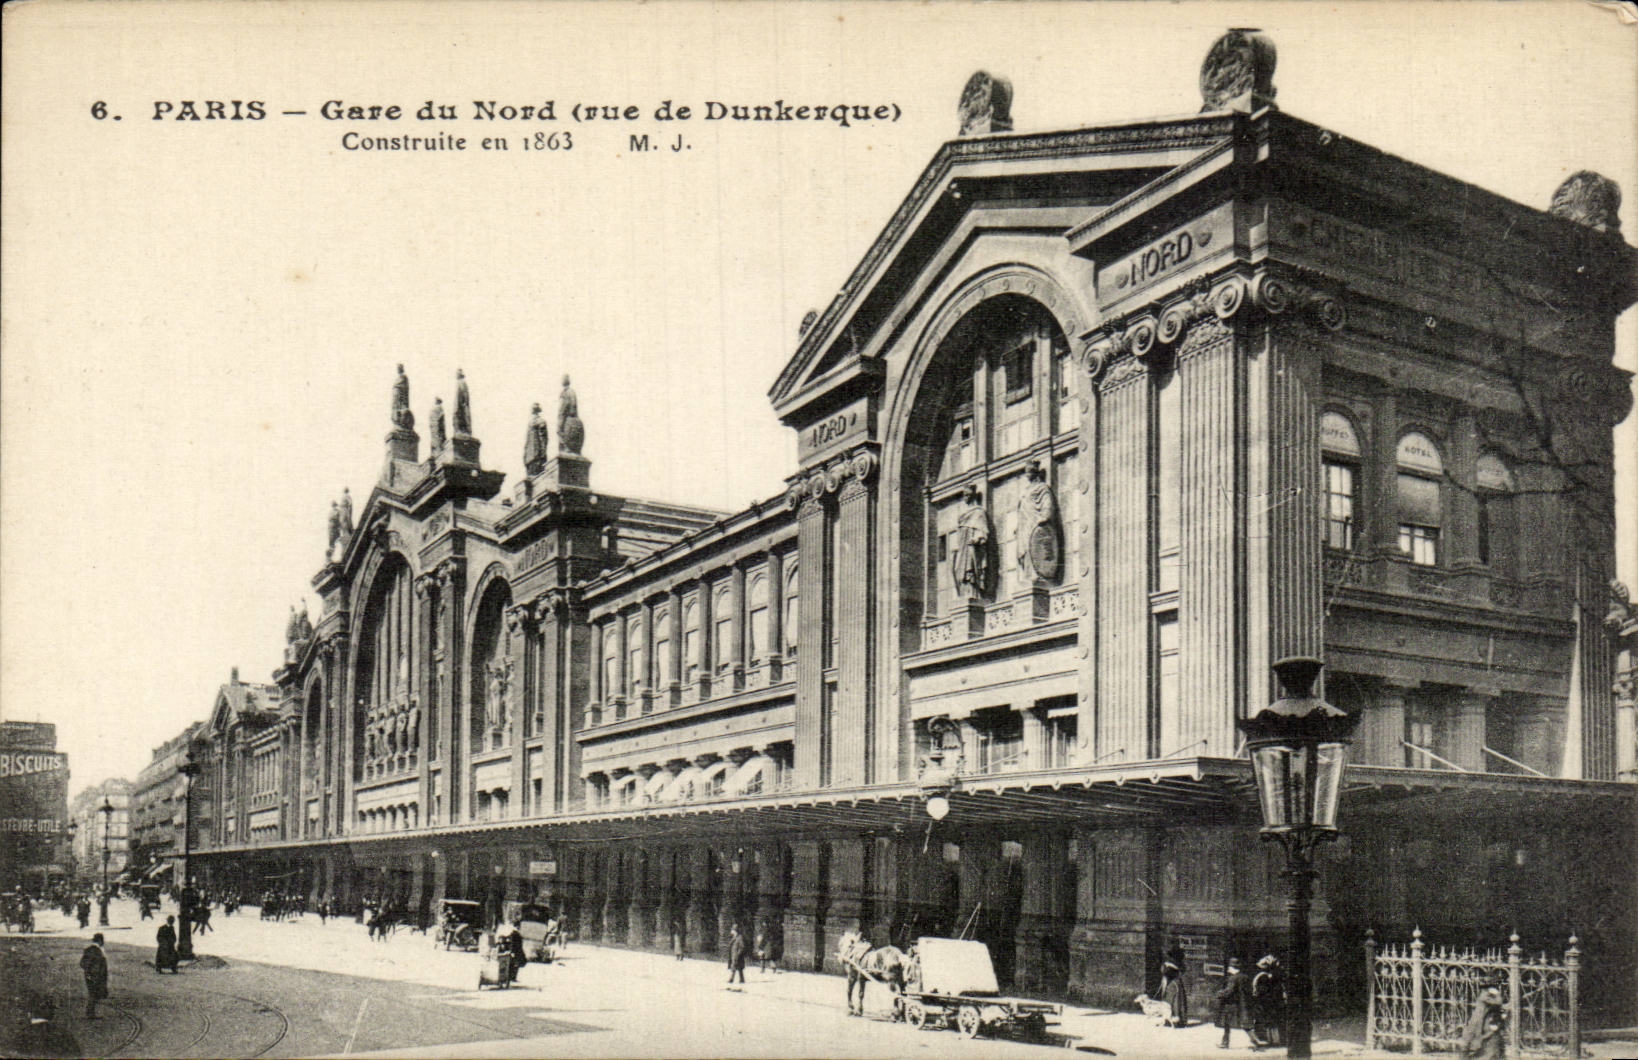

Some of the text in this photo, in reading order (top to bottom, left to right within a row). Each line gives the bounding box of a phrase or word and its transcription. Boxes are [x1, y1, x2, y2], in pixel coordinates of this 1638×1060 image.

[1131, 231, 1193, 287] NORD
[813, 415, 847, 448] NORD
[1, 753, 61, 777] BISCUITS
